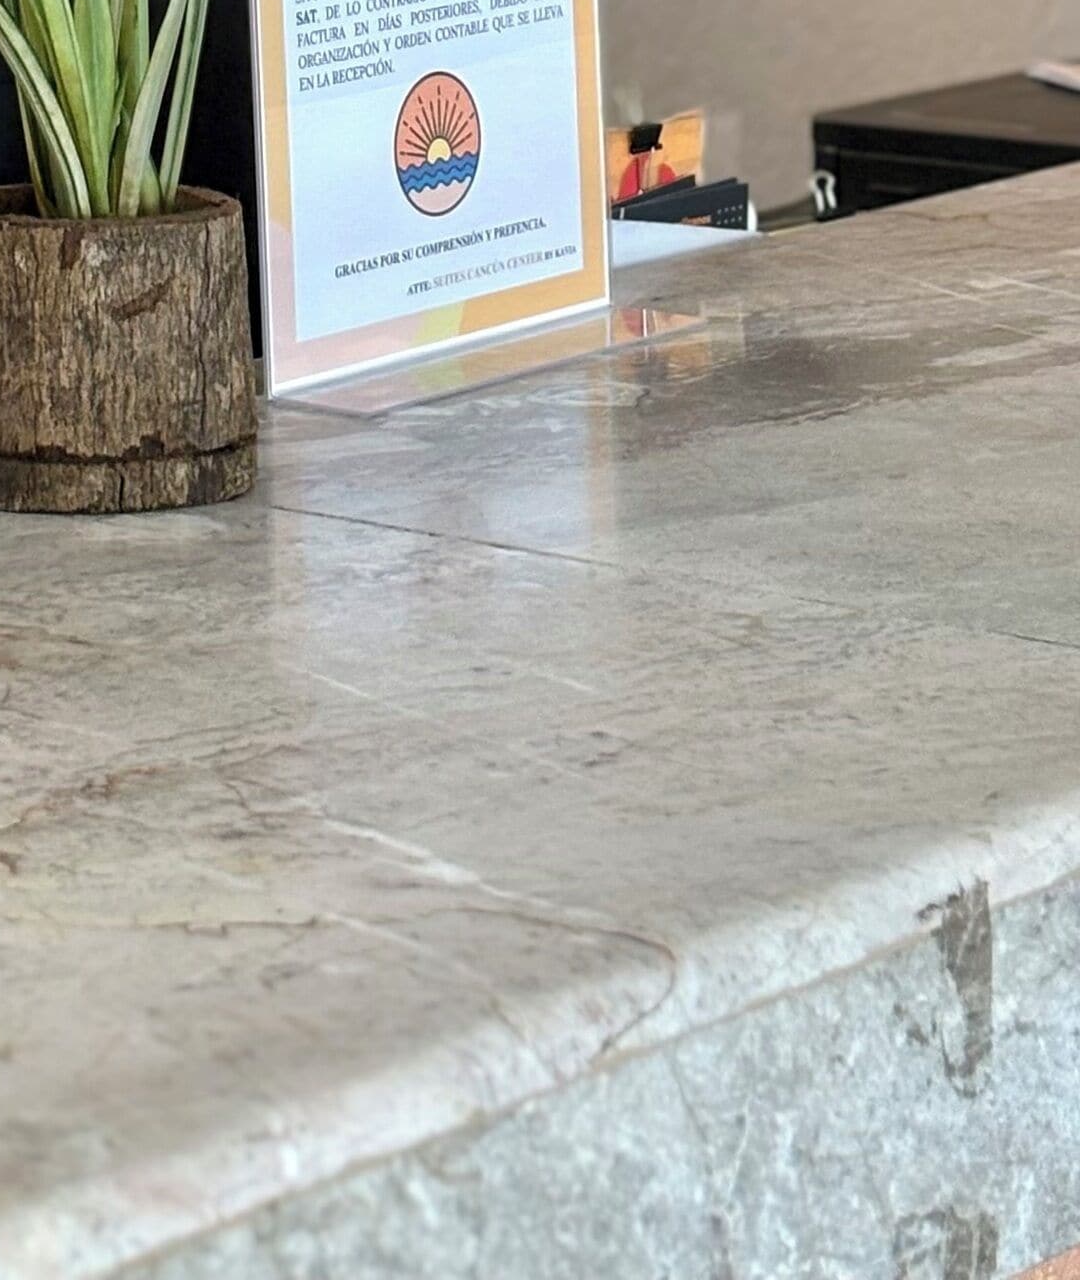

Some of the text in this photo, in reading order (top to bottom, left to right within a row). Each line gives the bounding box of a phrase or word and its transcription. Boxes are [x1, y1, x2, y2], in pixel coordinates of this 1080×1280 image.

[326, 4, 340, 21] DE
[346, 1, 361, 16] LO
[297, 26, 346, 48] FACTURA
[354, 20, 369, 37] EN
[378, 12, 402, 32] DÍAS
[298, 4, 564, 69] ORGANIZACIÓN Y ORDEN CONTABLE QUE SE LLEVA
[299, 75, 314, 91] EN
[317, 71, 330, 88] LA
[334, 255, 378, 279] GRACIAS
[380, 252, 401, 268] POR
[401, 248, 415, 263] SU
[415, 230, 484, 259] COMPRENSIÓN
[485, 228, 493, 241] Y
